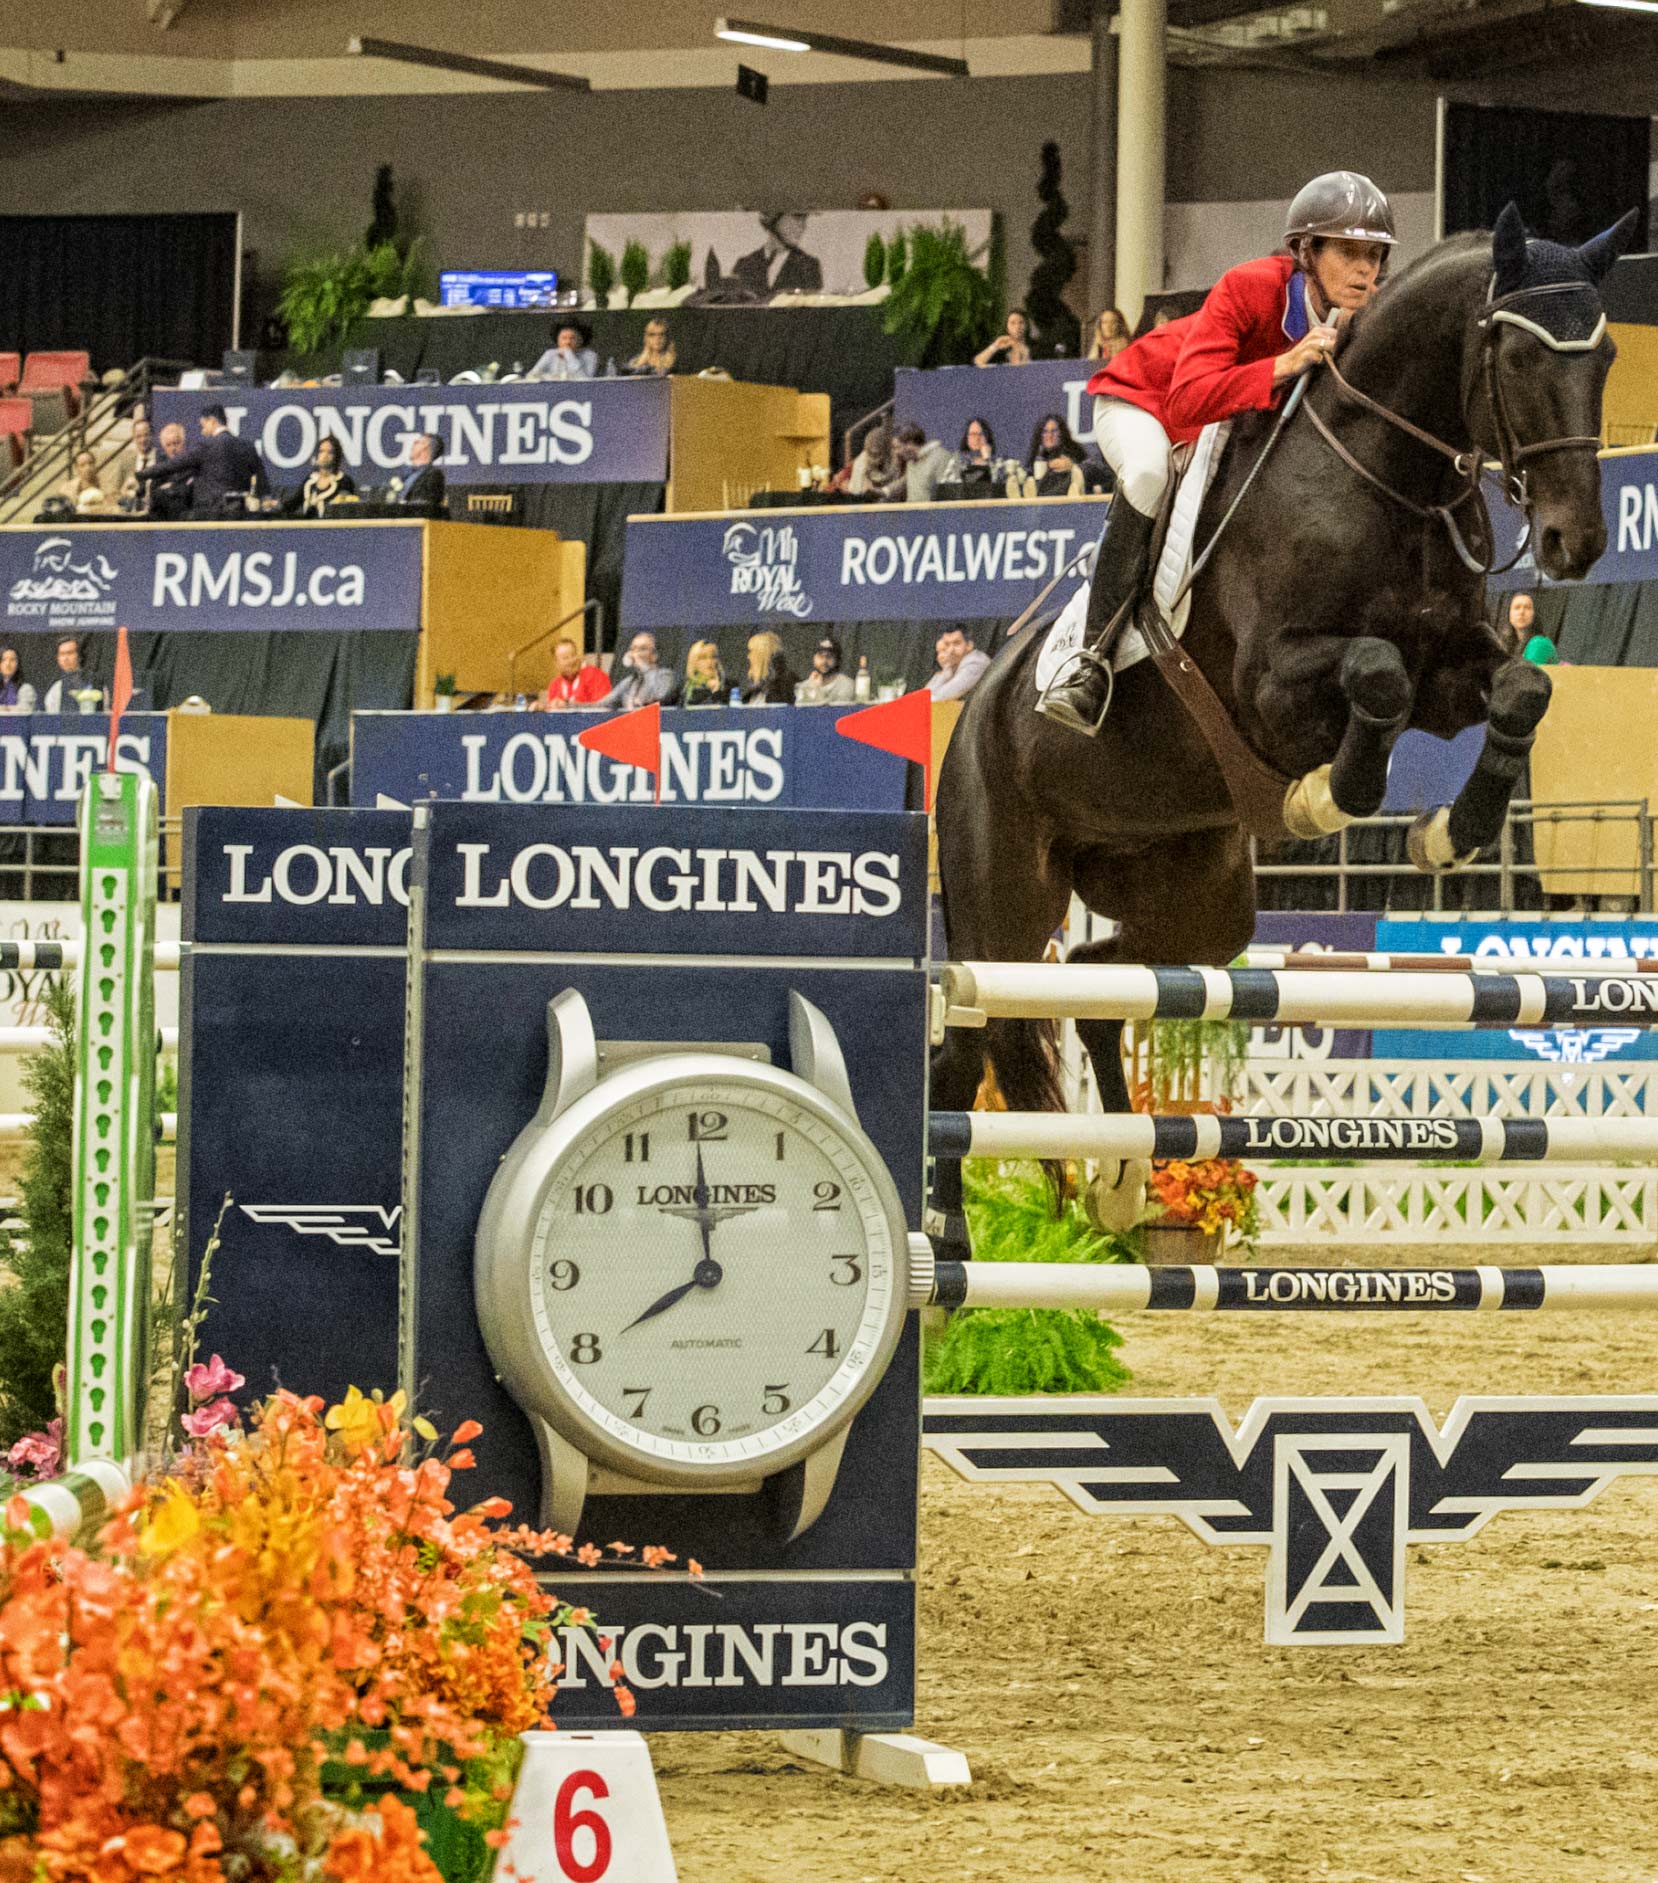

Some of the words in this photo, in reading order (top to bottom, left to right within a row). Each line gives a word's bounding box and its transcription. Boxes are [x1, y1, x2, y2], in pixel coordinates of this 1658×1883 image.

[152, 551, 365, 608] RMSJ.ca
[730, 563, 802, 594] ROYAL
[455, 842, 900, 917] LONGINES
[687, 1110, 728, 1142] 12
[1244, 1116, 1459, 1150] LONGINES
[624, 1131, 650, 1162] 11
[776, 1131, 785, 1161] 1
[574, 1183, 614, 1214] 10
[813, 1180, 842, 1212] 2
[549, 1259, 580, 1291] 9
[829, 1254, 862, 1287] 3
[1245, 1270, 1457, 1303] LONGINES
[570, 1332, 603, 1365] 8
[671, 1337, 743, 1349] AUTOMATIC
[805, 1328, 840, 1359] 4
[622, 1387, 652, 1419] 7
[761, 1383, 792, 1416] 5
[691, 1404, 721, 1437] 6
[552, 1768, 613, 1883] 6
